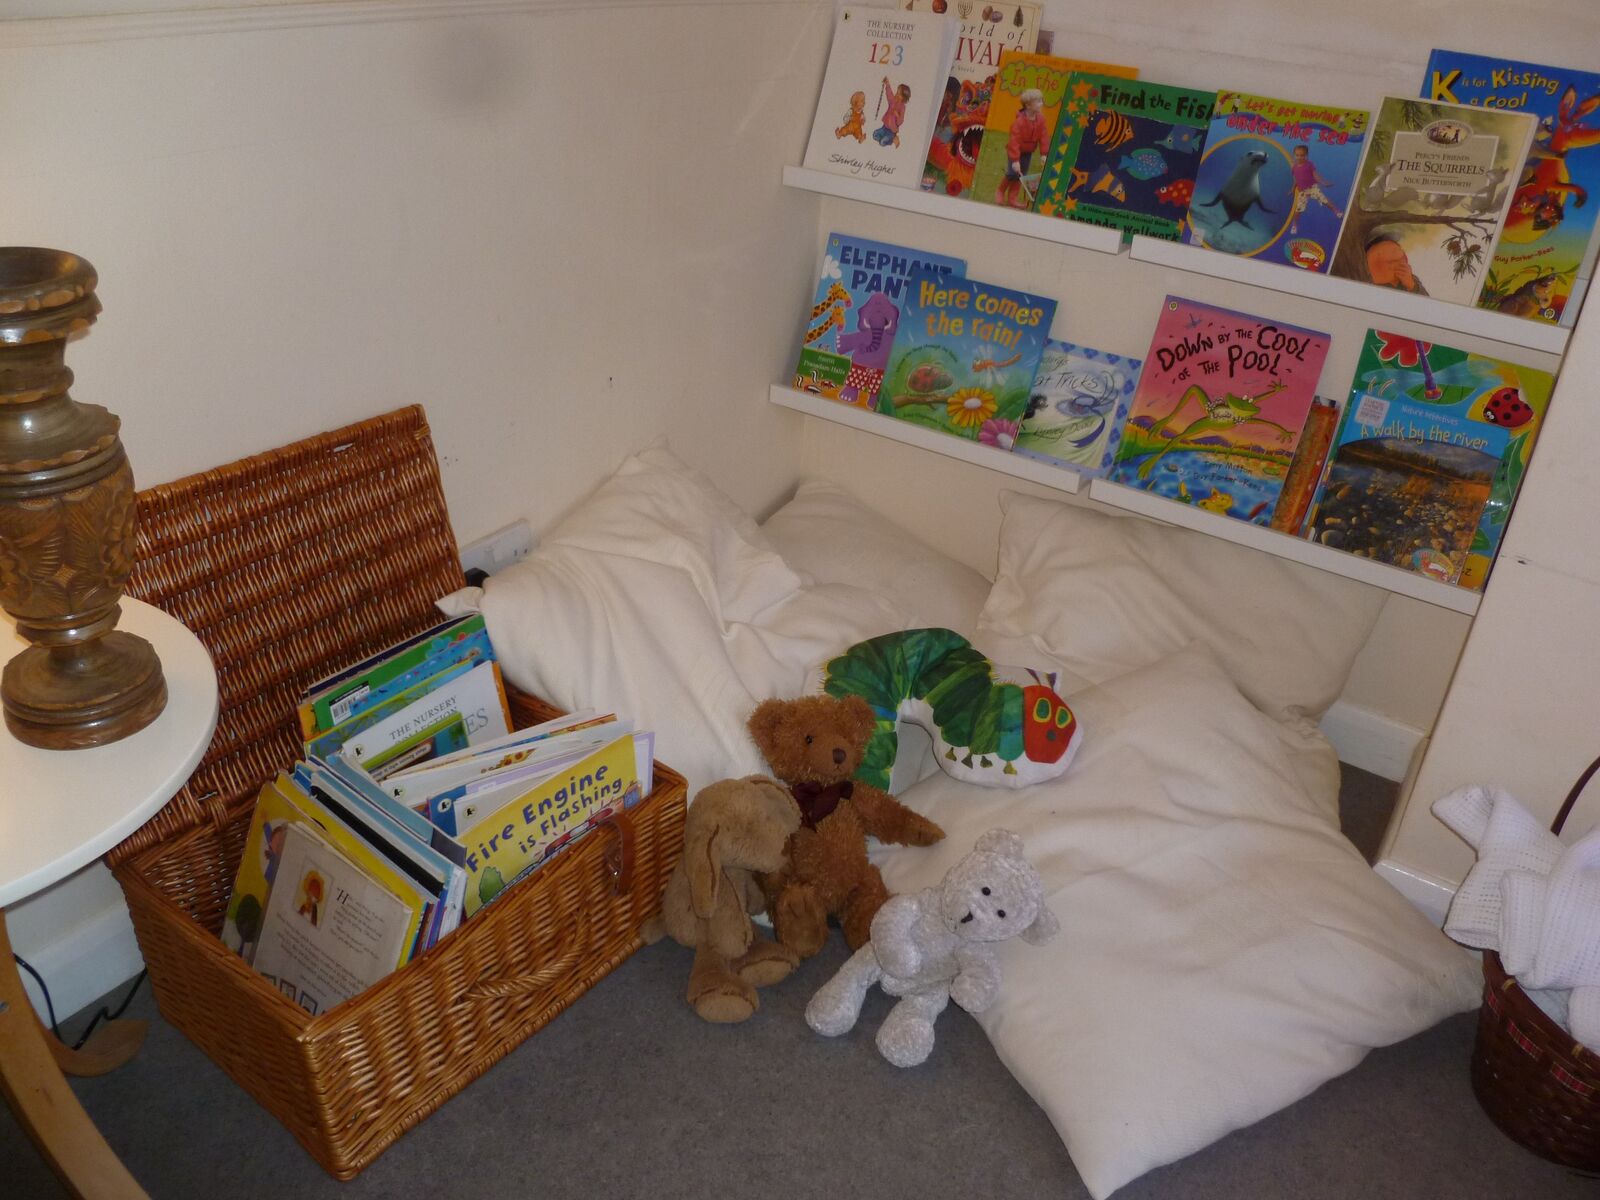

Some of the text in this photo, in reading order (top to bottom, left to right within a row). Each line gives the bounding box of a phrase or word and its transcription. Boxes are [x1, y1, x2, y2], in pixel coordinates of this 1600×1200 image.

[866, 29, 913, 41] COLLECTION
[867, 20, 915, 32] THE NURSERY
[1007, 28, 1027, 45] of
[1100, 84, 1147, 111] Find
[1149, 93, 1172, 111] the
[1431, 68, 1462, 105] K
[1472, 77, 1488, 87] for
[1491, 66, 1561, 96] Kissing
[1470, 97, 1479, 106] a
[1282, 121, 1314, 142] the
[1318, 130, 1350, 145] sea
[1398, 159, 1486, 176] THE SQUIRRELS
[919, 280, 1045, 327] Here comes
[926, 310, 965, 338] the
[1156, 332, 1214, 372] DOWN
[1217, 332, 1231, 344] BY
[1234, 328, 1254, 340] THE
[1197, 359, 1221, 376] THE
[1360, 419, 1489, 450] A walk by the river
[389, 695, 457, 741] THE NURSERY
[466, 764, 609, 874] Fire Engine
[518, 833, 537, 854] is
